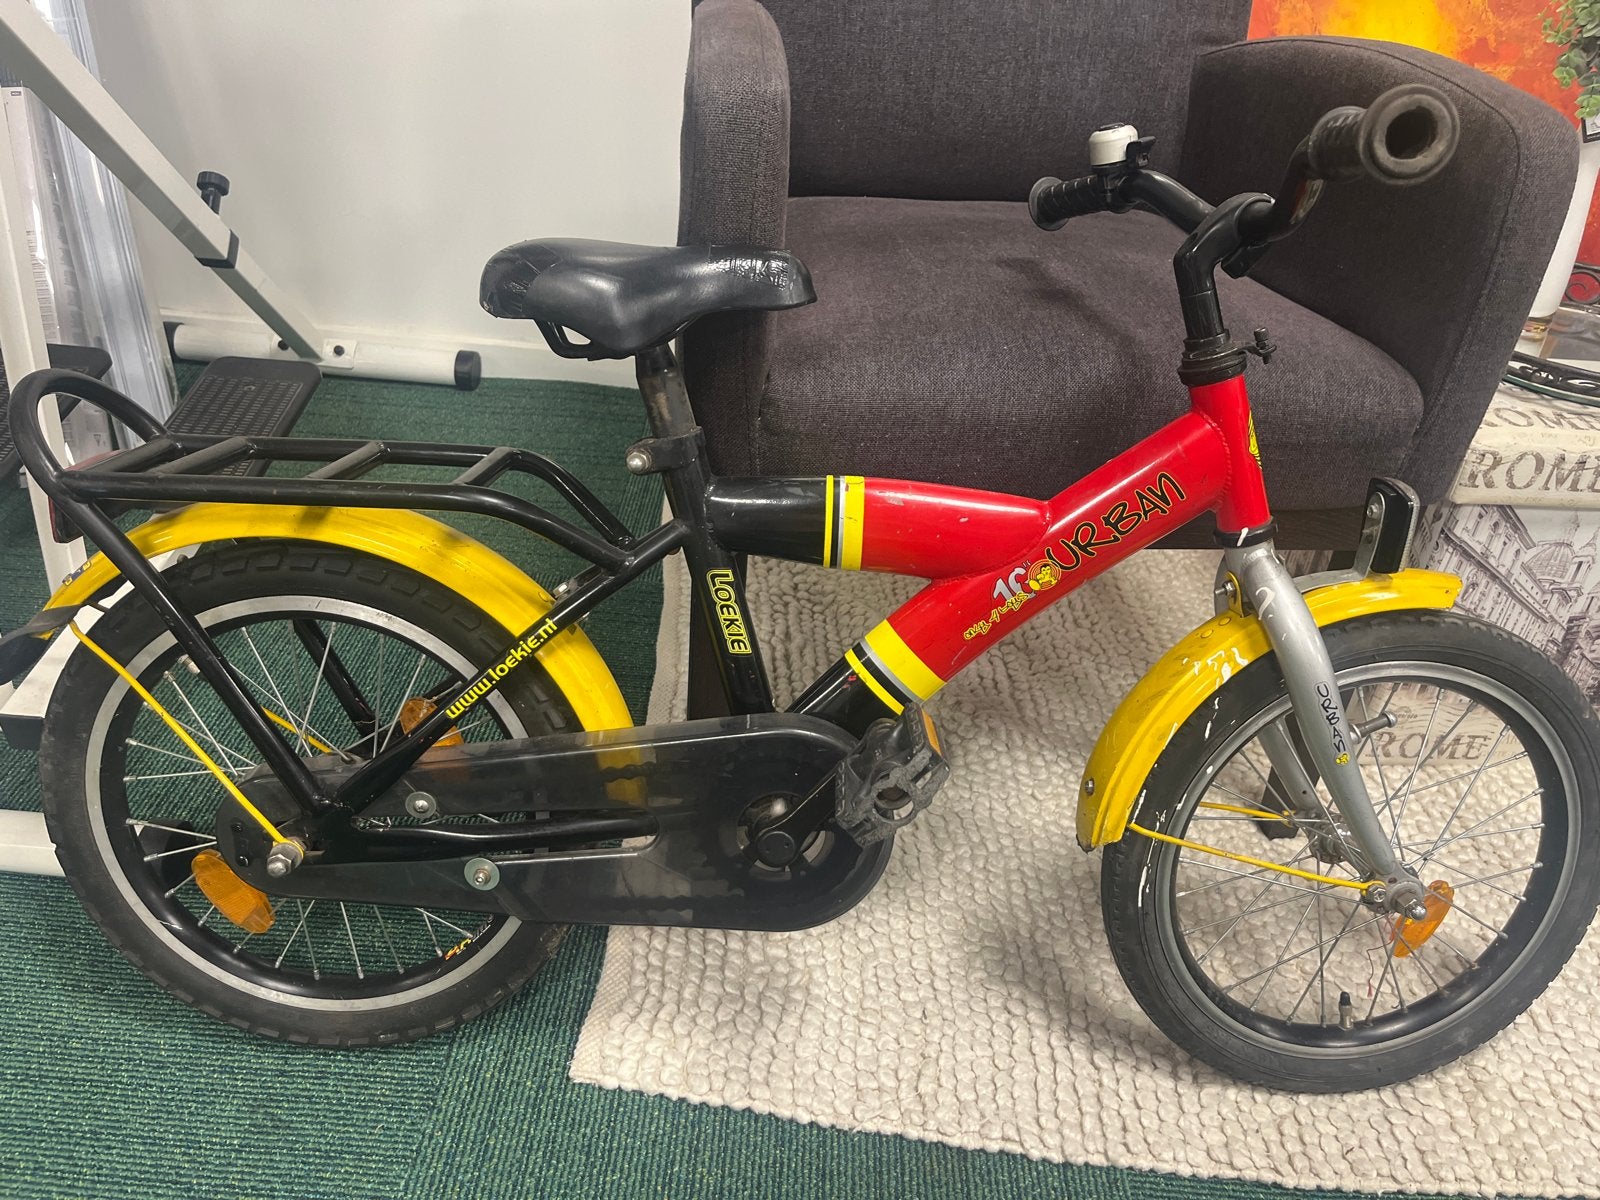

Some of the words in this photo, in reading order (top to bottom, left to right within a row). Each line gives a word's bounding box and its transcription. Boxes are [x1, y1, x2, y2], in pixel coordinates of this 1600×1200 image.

[1045, 472, 1186, 571] URBAN
[706, 569, 752, 655] LOEKIE
[989, 608, 1001, 623] 4
[445, 617, 558, 719] www.loekie.nl
[1314, 683, 1347, 753] URBAN
[1365, 731, 1492, 760] ROME
